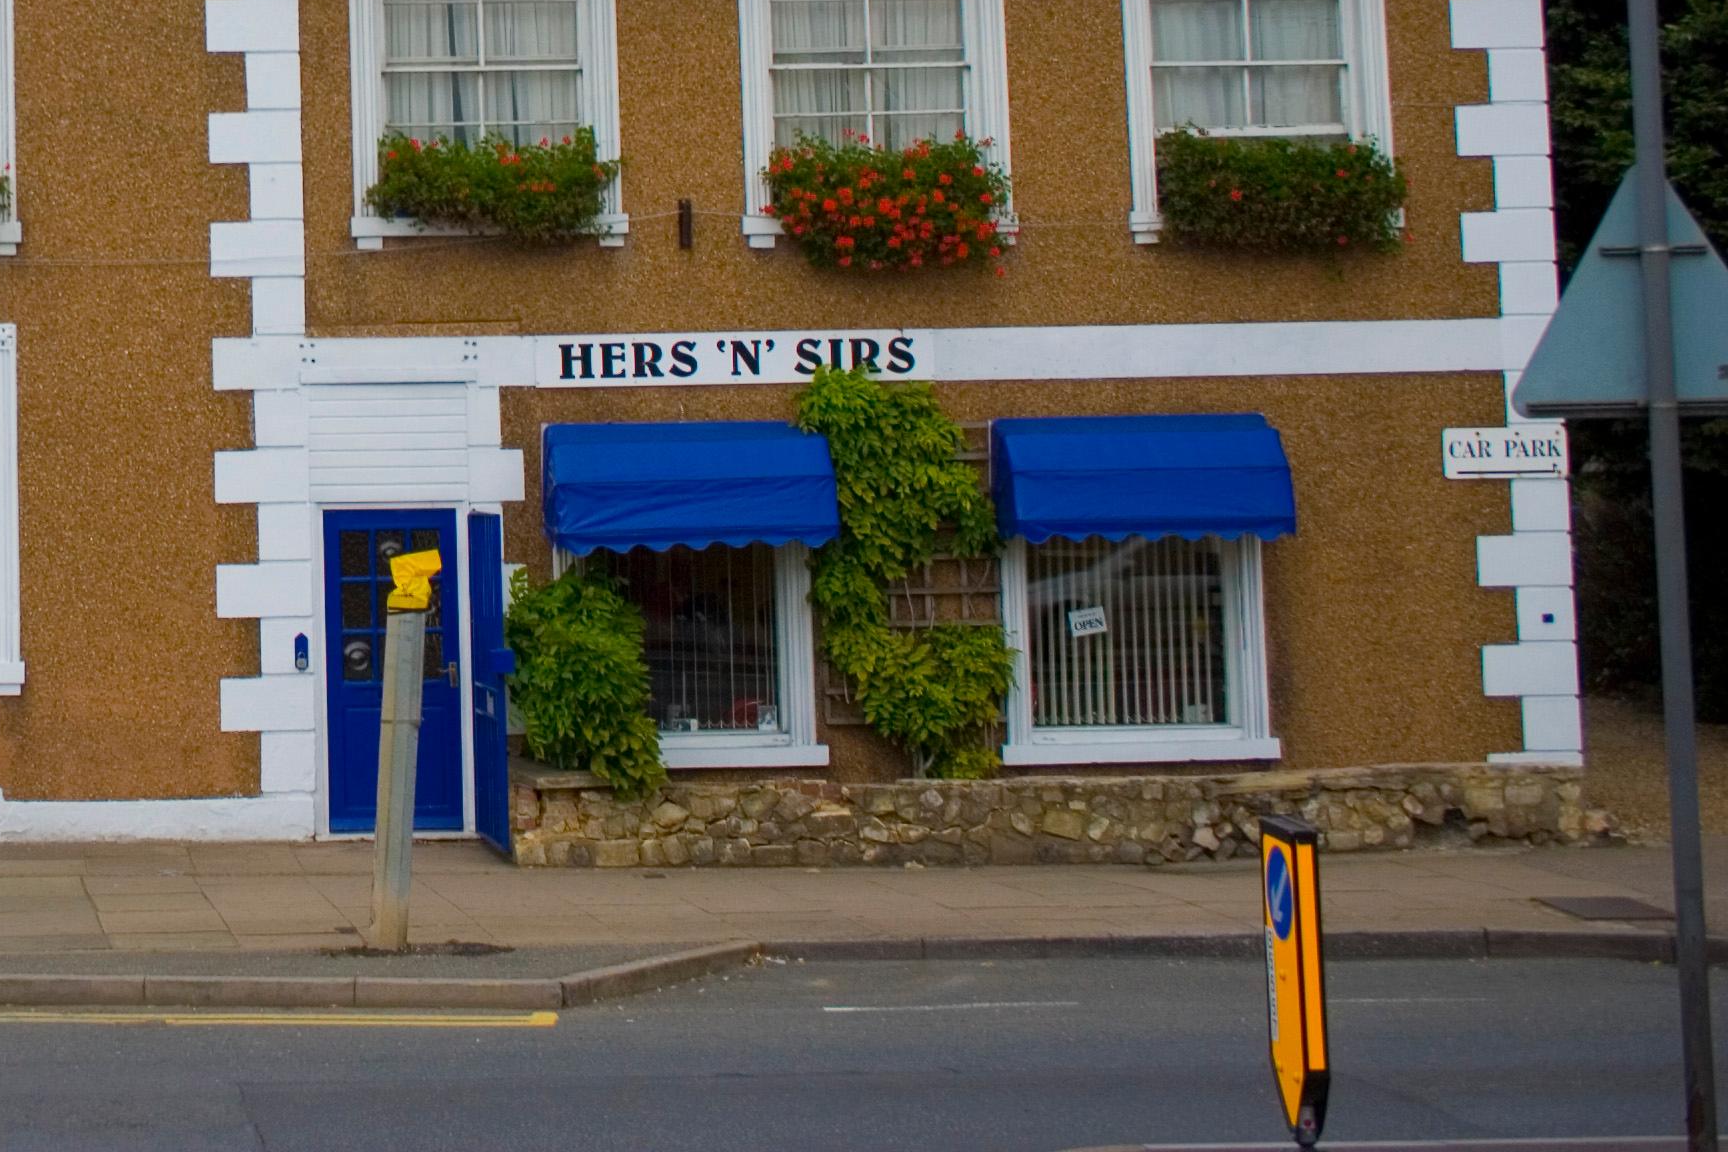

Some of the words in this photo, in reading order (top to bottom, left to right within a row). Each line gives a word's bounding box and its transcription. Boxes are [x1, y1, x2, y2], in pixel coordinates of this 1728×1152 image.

[558, 339, 699, 380] HERS
[794, 336, 917, 376] SIRS
[1448, 439, 1493, 459] CAR
[1503, 438, 1562, 459] PARK
[1074, 616, 1105, 631] OPEN
